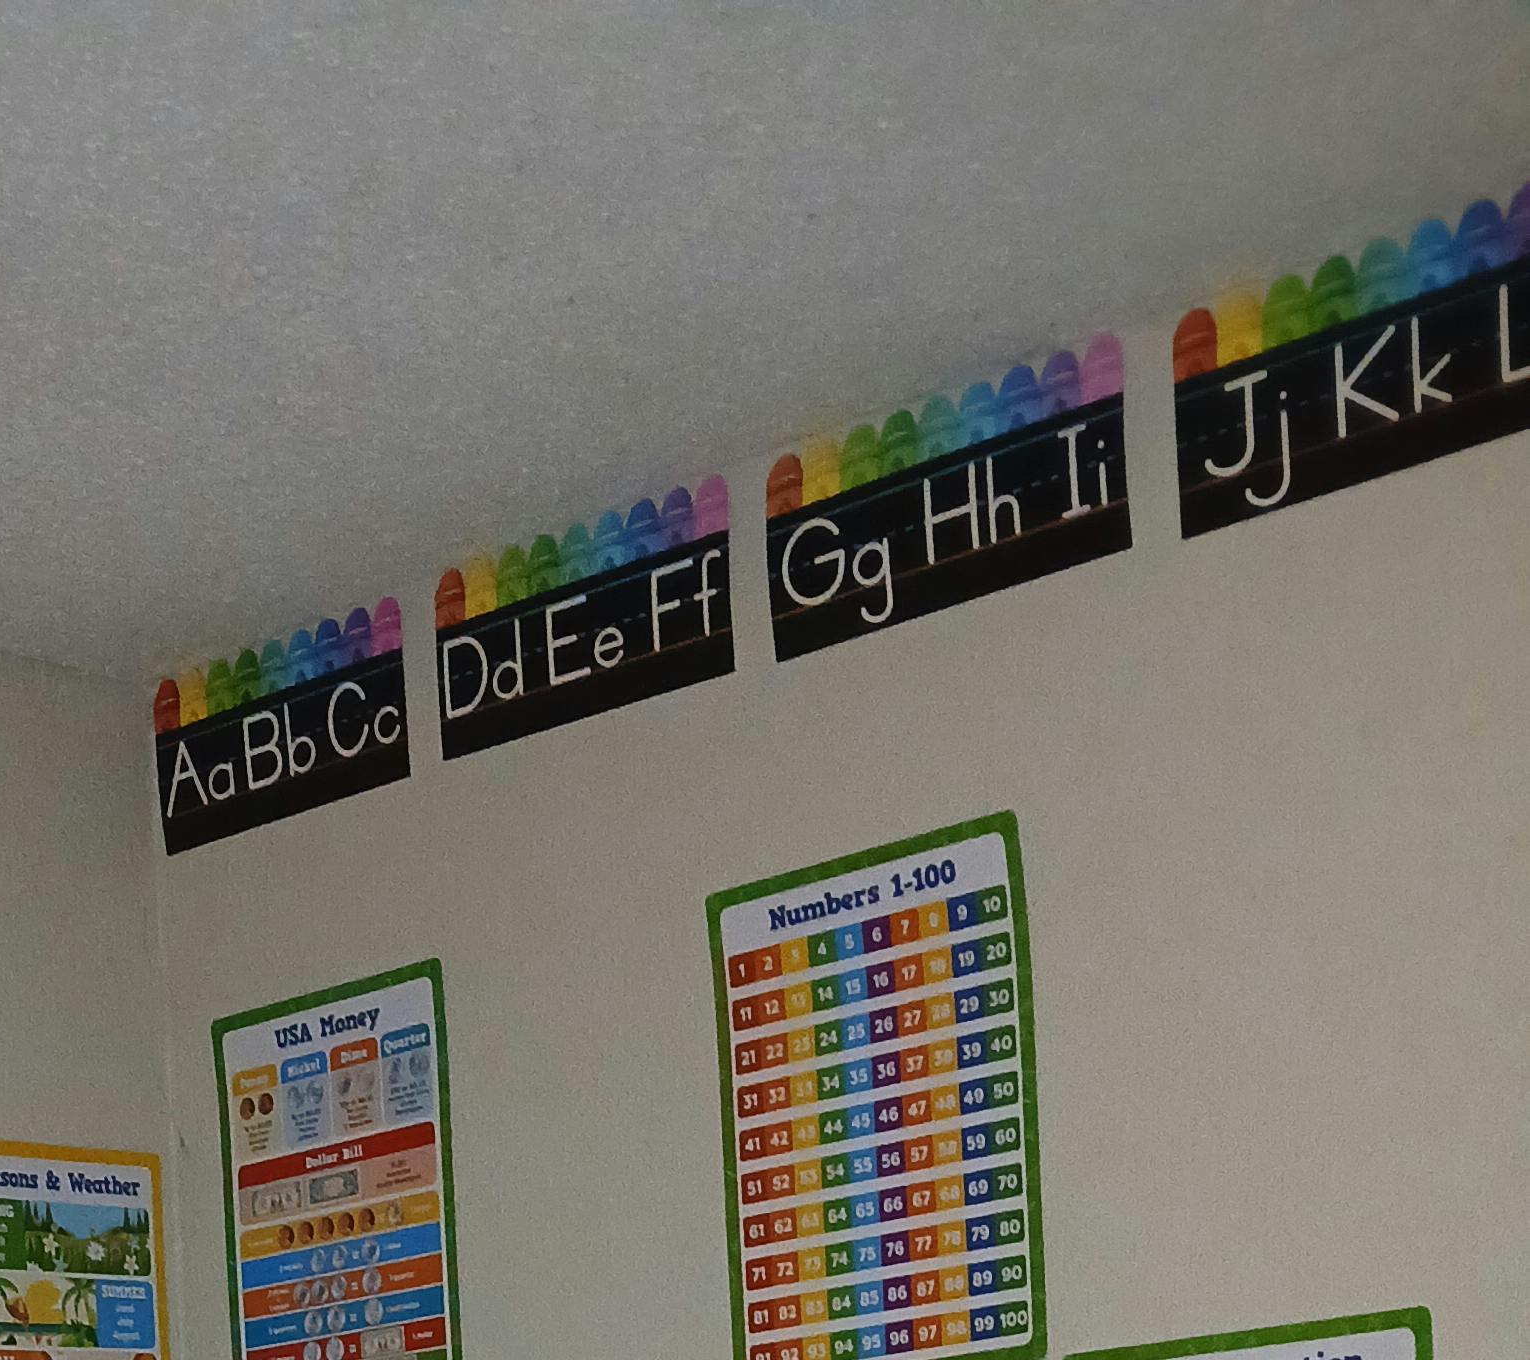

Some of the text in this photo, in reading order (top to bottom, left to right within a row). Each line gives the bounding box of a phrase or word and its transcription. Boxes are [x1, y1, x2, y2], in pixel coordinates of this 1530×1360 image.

[1203, 369, 1292, 507] Jj
[1334, 313, 1453, 439] Kk
[781, 425, 1107, 624] Gg Hh Ii
[442, 546, 723, 722] Dd Ee Ff
[166, 682, 401, 819] Aa Bb Cc
[768, 858, 957, 930] Numbers 1-100
[983, 895, 1001, 913] 10
[984, 941, 1007, 962] 20
[988, 986, 1010, 1007] 30
[274, 1007, 381, 1049] USA Money
[990, 1033, 1013, 1054] 40
[992, 1080, 1015, 1100] 50
[994, 1126, 1017, 1146] 60
[305, 1144, 364, 1169] Dollar Bill
[45, 1170, 60, 1191] &
[68, 1172, 141, 1197] Weather
[996, 1174, 1018, 1193] 70
[999, 1217, 1021, 1237] 80
[1001, 1264, 1023, 1283] 90
[999, 1309, 1029, 1328] 100
